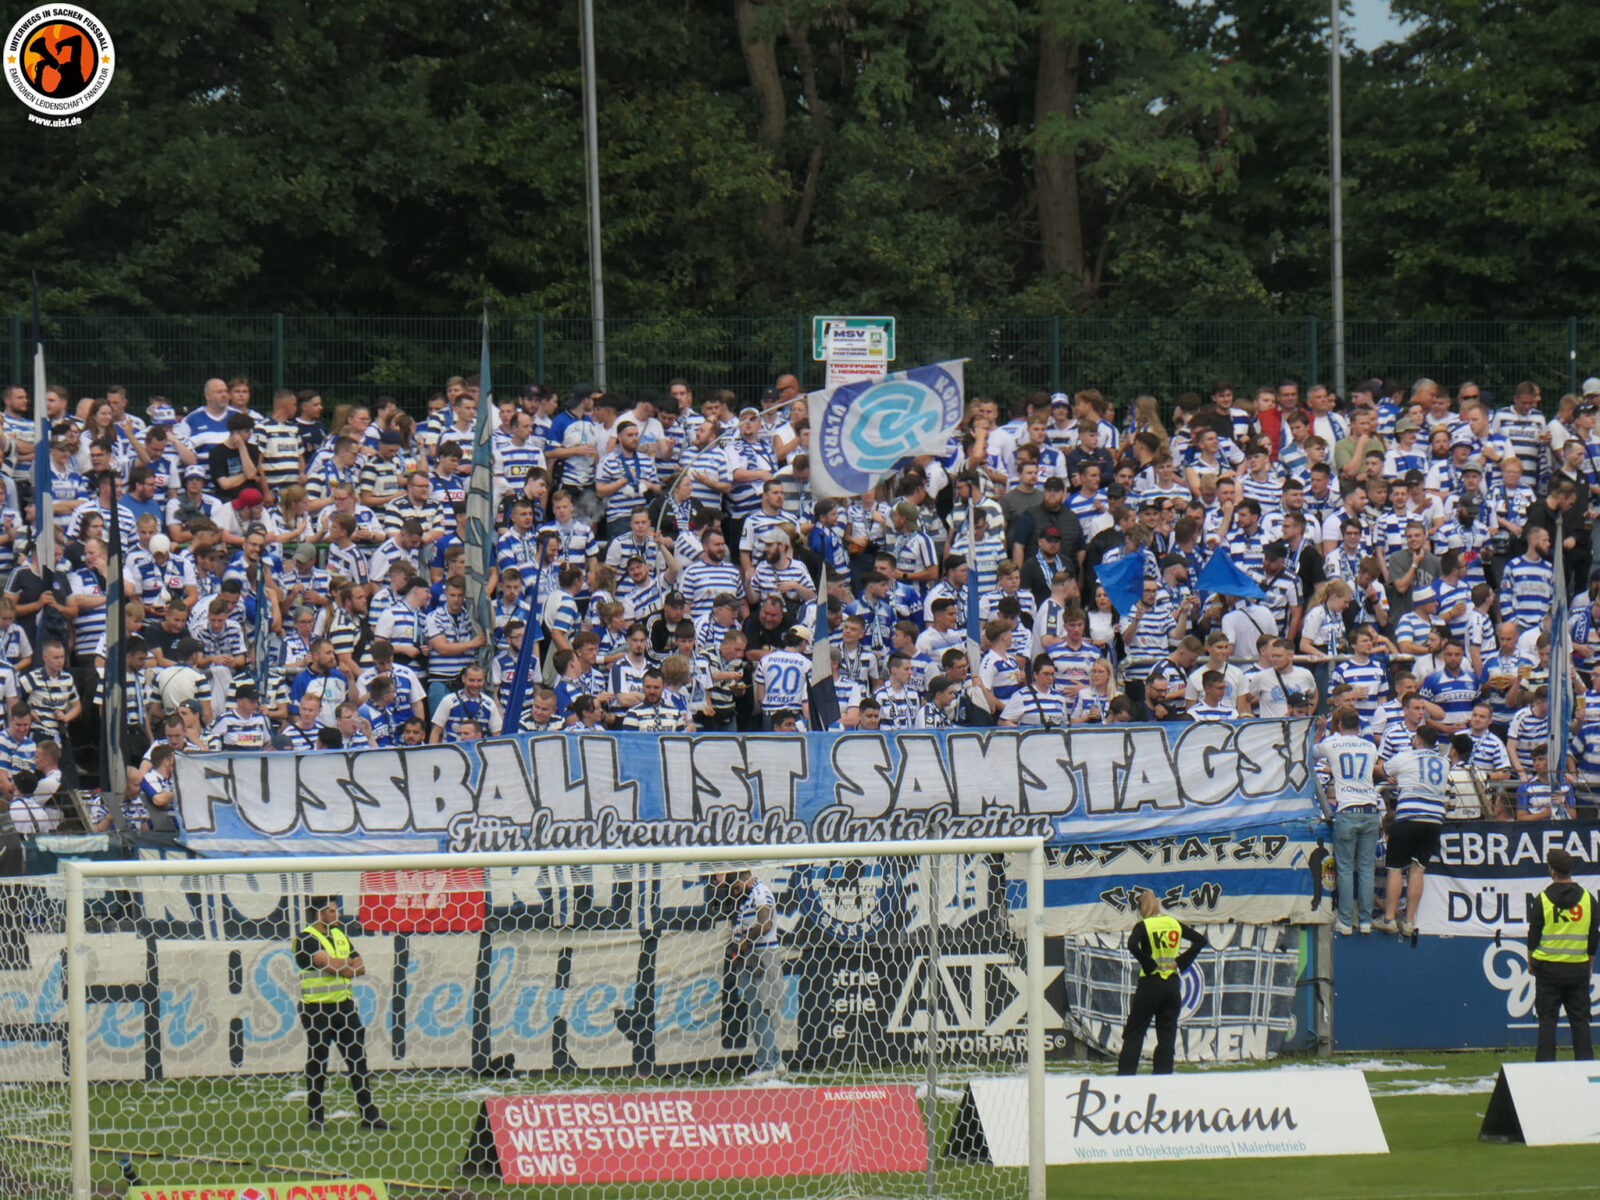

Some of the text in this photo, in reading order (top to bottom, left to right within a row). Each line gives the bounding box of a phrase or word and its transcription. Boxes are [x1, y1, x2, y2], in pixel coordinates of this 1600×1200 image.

[834, 330, 865, 338] MSV
[824, 403, 848, 468] ULTRAS
[768, 656, 804, 666] DUISBURG
[767, 664, 801, 695] 20
[175, 719, 1316, 834] FUSSBALL IST SAMSTAGS!
[1339, 752, 1368, 780] 07
[1418, 756, 1444, 786] 18
[449, 802, 1054, 852] Für fanfreundliche Anstoßzeiten
[1430, 829, 1600, 866] EBRAFA
[1552, 903, 1584, 924] K9
[1152, 929, 1180, 949] K9
[886, 953, 1066, 1036] ATX
[824, 1088, 887, 1100] HAGEDORN
[1065, 1078, 1298, 1138] Rickmann
[505, 1099, 696, 1128] GÜTERSLOHER
[509, 1121, 793, 1153] WERTSTOFFZENTRUM
[1113, 1146, 1133, 1157] und
[1136, 1143, 1231, 1159] Objektgestaltung
[1238, 1140, 1307, 1154] Malerbetrieb
[516, 1153, 577, 1178] GWG
